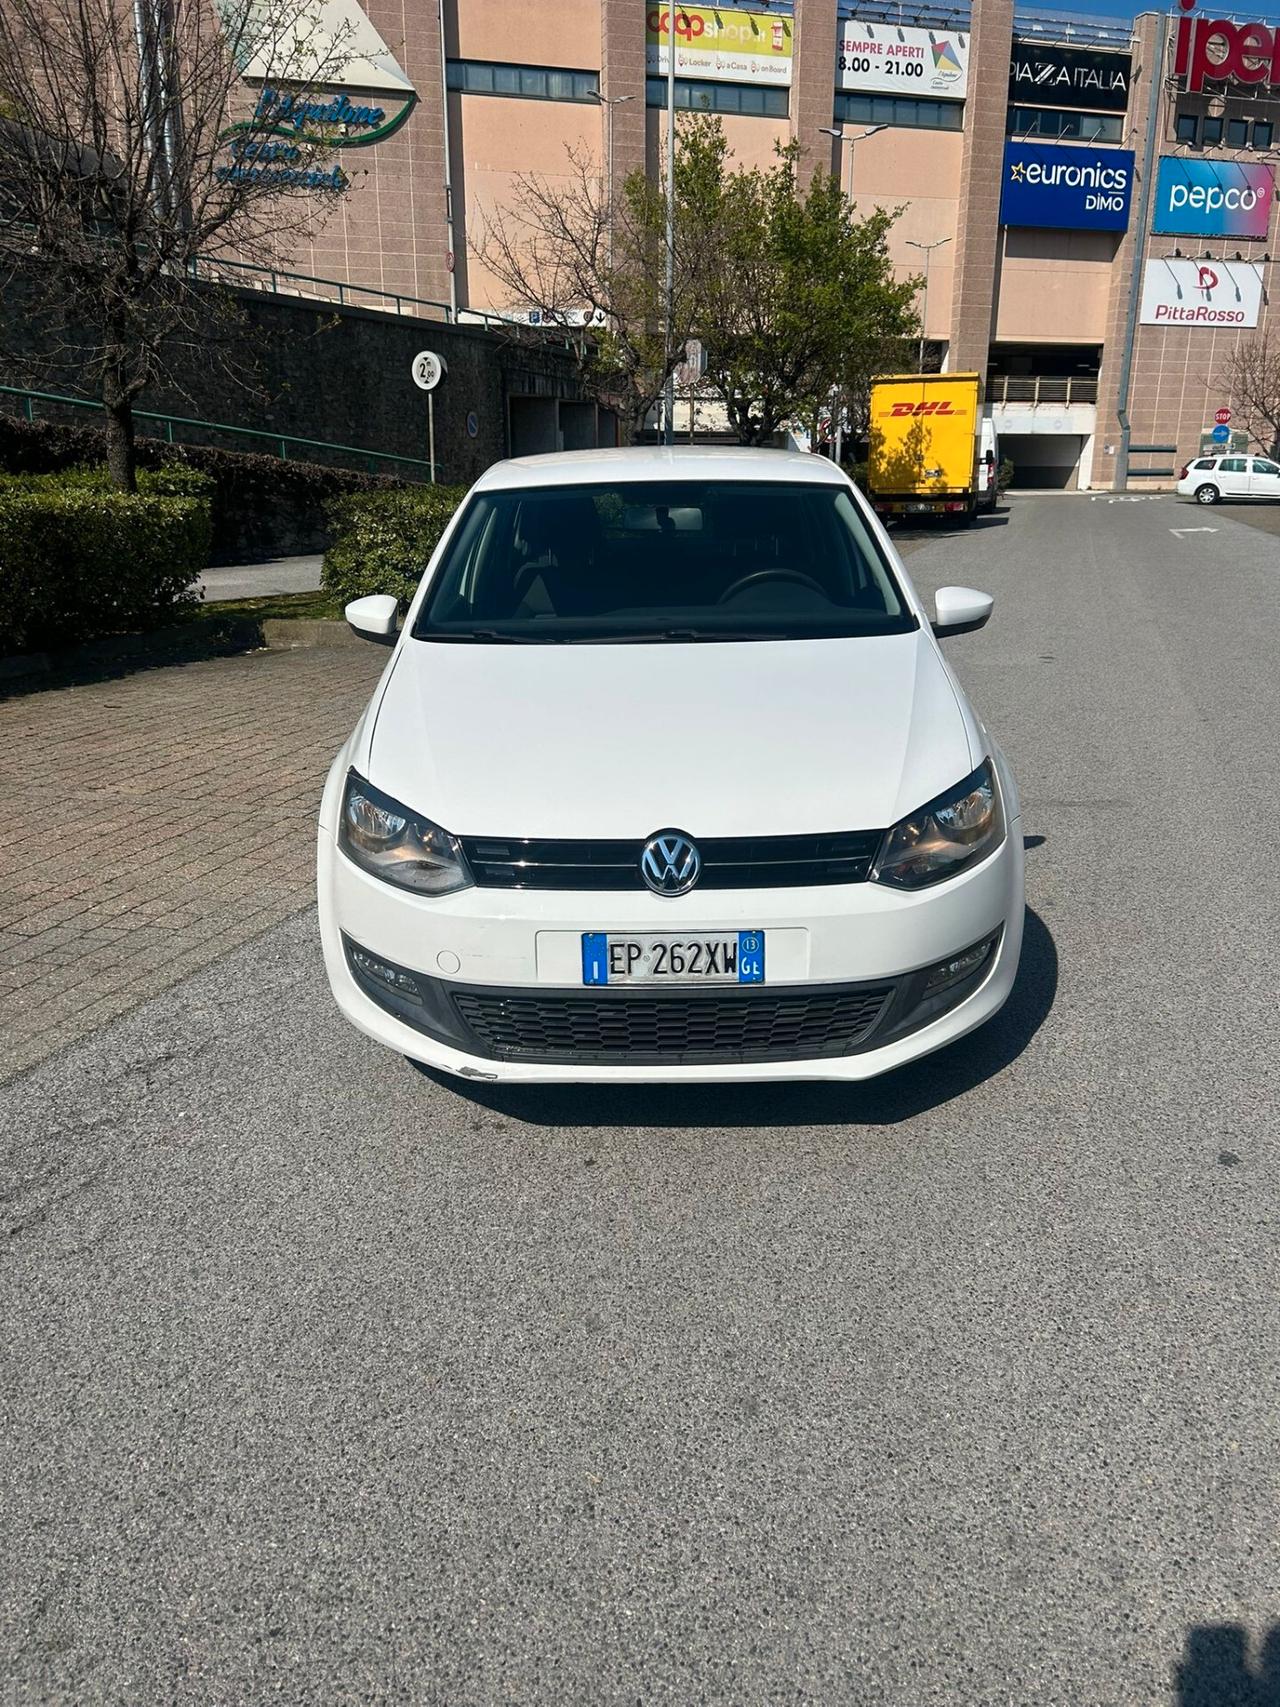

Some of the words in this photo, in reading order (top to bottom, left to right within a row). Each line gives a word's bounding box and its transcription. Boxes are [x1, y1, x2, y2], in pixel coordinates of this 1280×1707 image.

[839, 40, 883, 55] SEMPRE
[886, 44, 925, 59] APERTI
[689, 58, 711, 67] Locker
[838, 56, 870, 72] 8.00
[885, 60, 924, 78] 21.00
[1074, 67, 1127, 91] ITALIA
[1026, 161, 1127, 190] euronics
[1169, 183, 1258, 214] pepco
[1154, 304, 1245, 323] PittaRosso
[890, 401, 955, 417] DHL
[746, 939, 756, 950] 13
[610, 943, 642, 975] EP
[652, 942, 738, 975] 262XW
